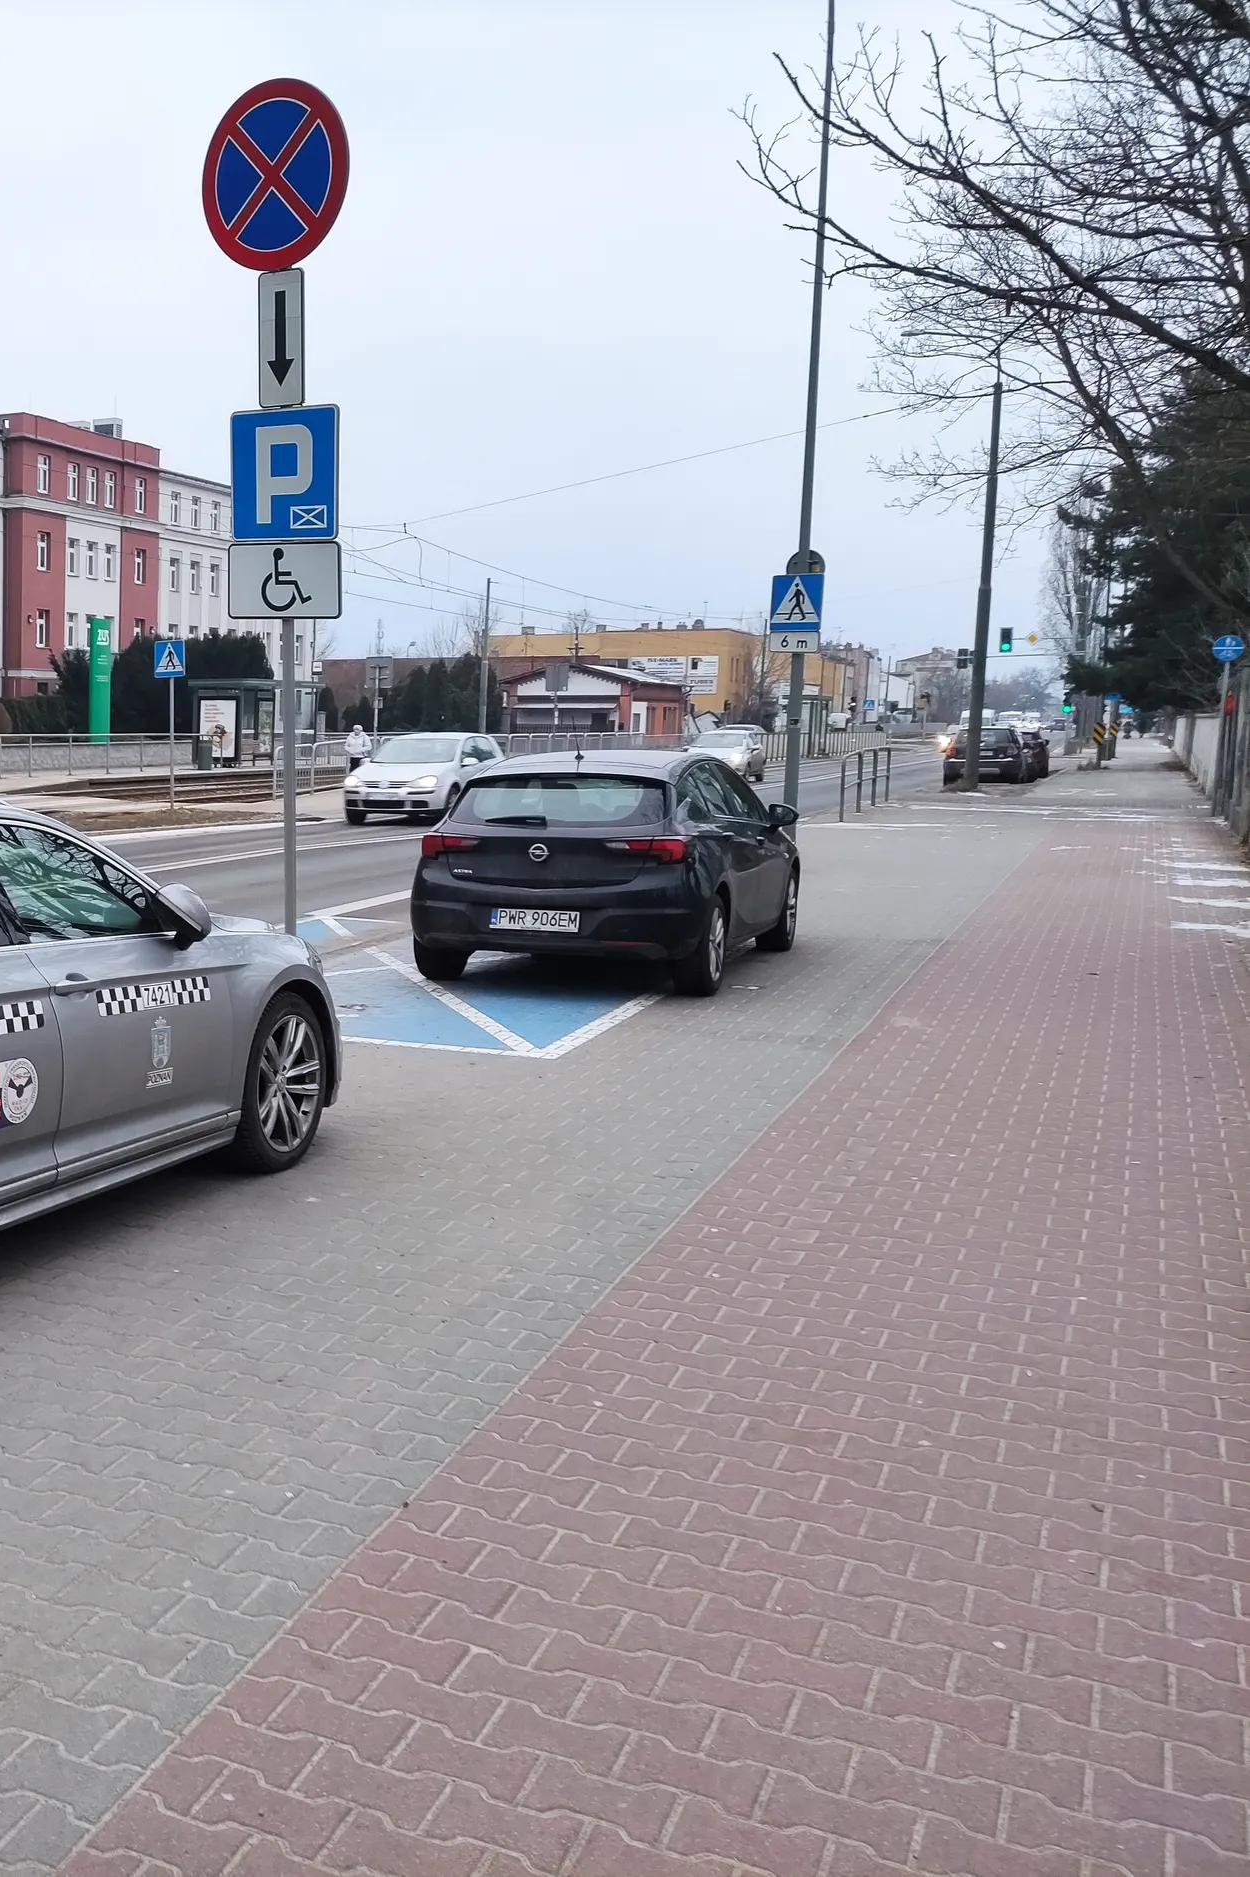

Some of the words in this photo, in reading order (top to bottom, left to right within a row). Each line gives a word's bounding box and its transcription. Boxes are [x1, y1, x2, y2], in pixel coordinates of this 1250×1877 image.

[255, 423, 314, 524] P
[780, 635, 789, 648] 6
[796, 639, 808, 649] m
[498, 909, 527, 926] PWR
[531, 911, 579, 929] 906EM
[143, 986, 174, 1007] 7421
